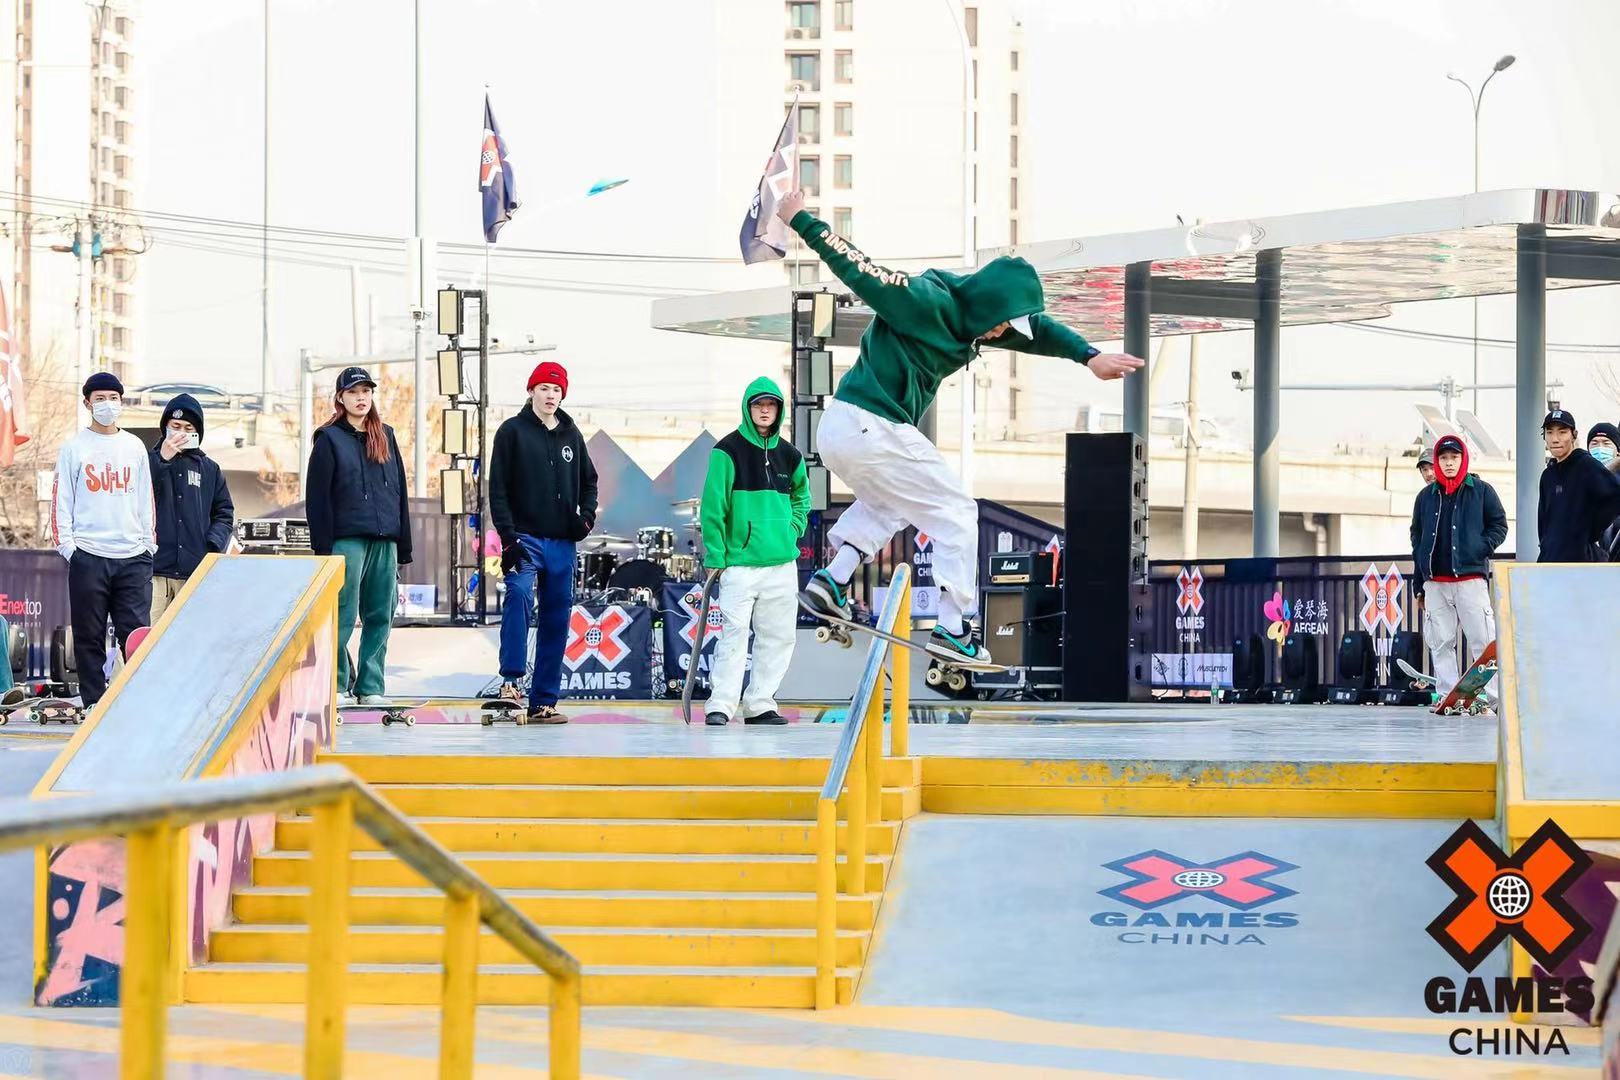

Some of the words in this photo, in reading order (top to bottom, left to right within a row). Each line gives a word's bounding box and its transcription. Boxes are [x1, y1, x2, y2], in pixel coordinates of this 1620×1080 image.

[1293, 599, 1328, 620] 爱琴海
[1175, 616, 1205, 630] GAMES
[1179, 632, 1200, 643] CHINA
[1089, 911, 1300, 928] GAMES
[1117, 932, 1267, 946] CHINA
